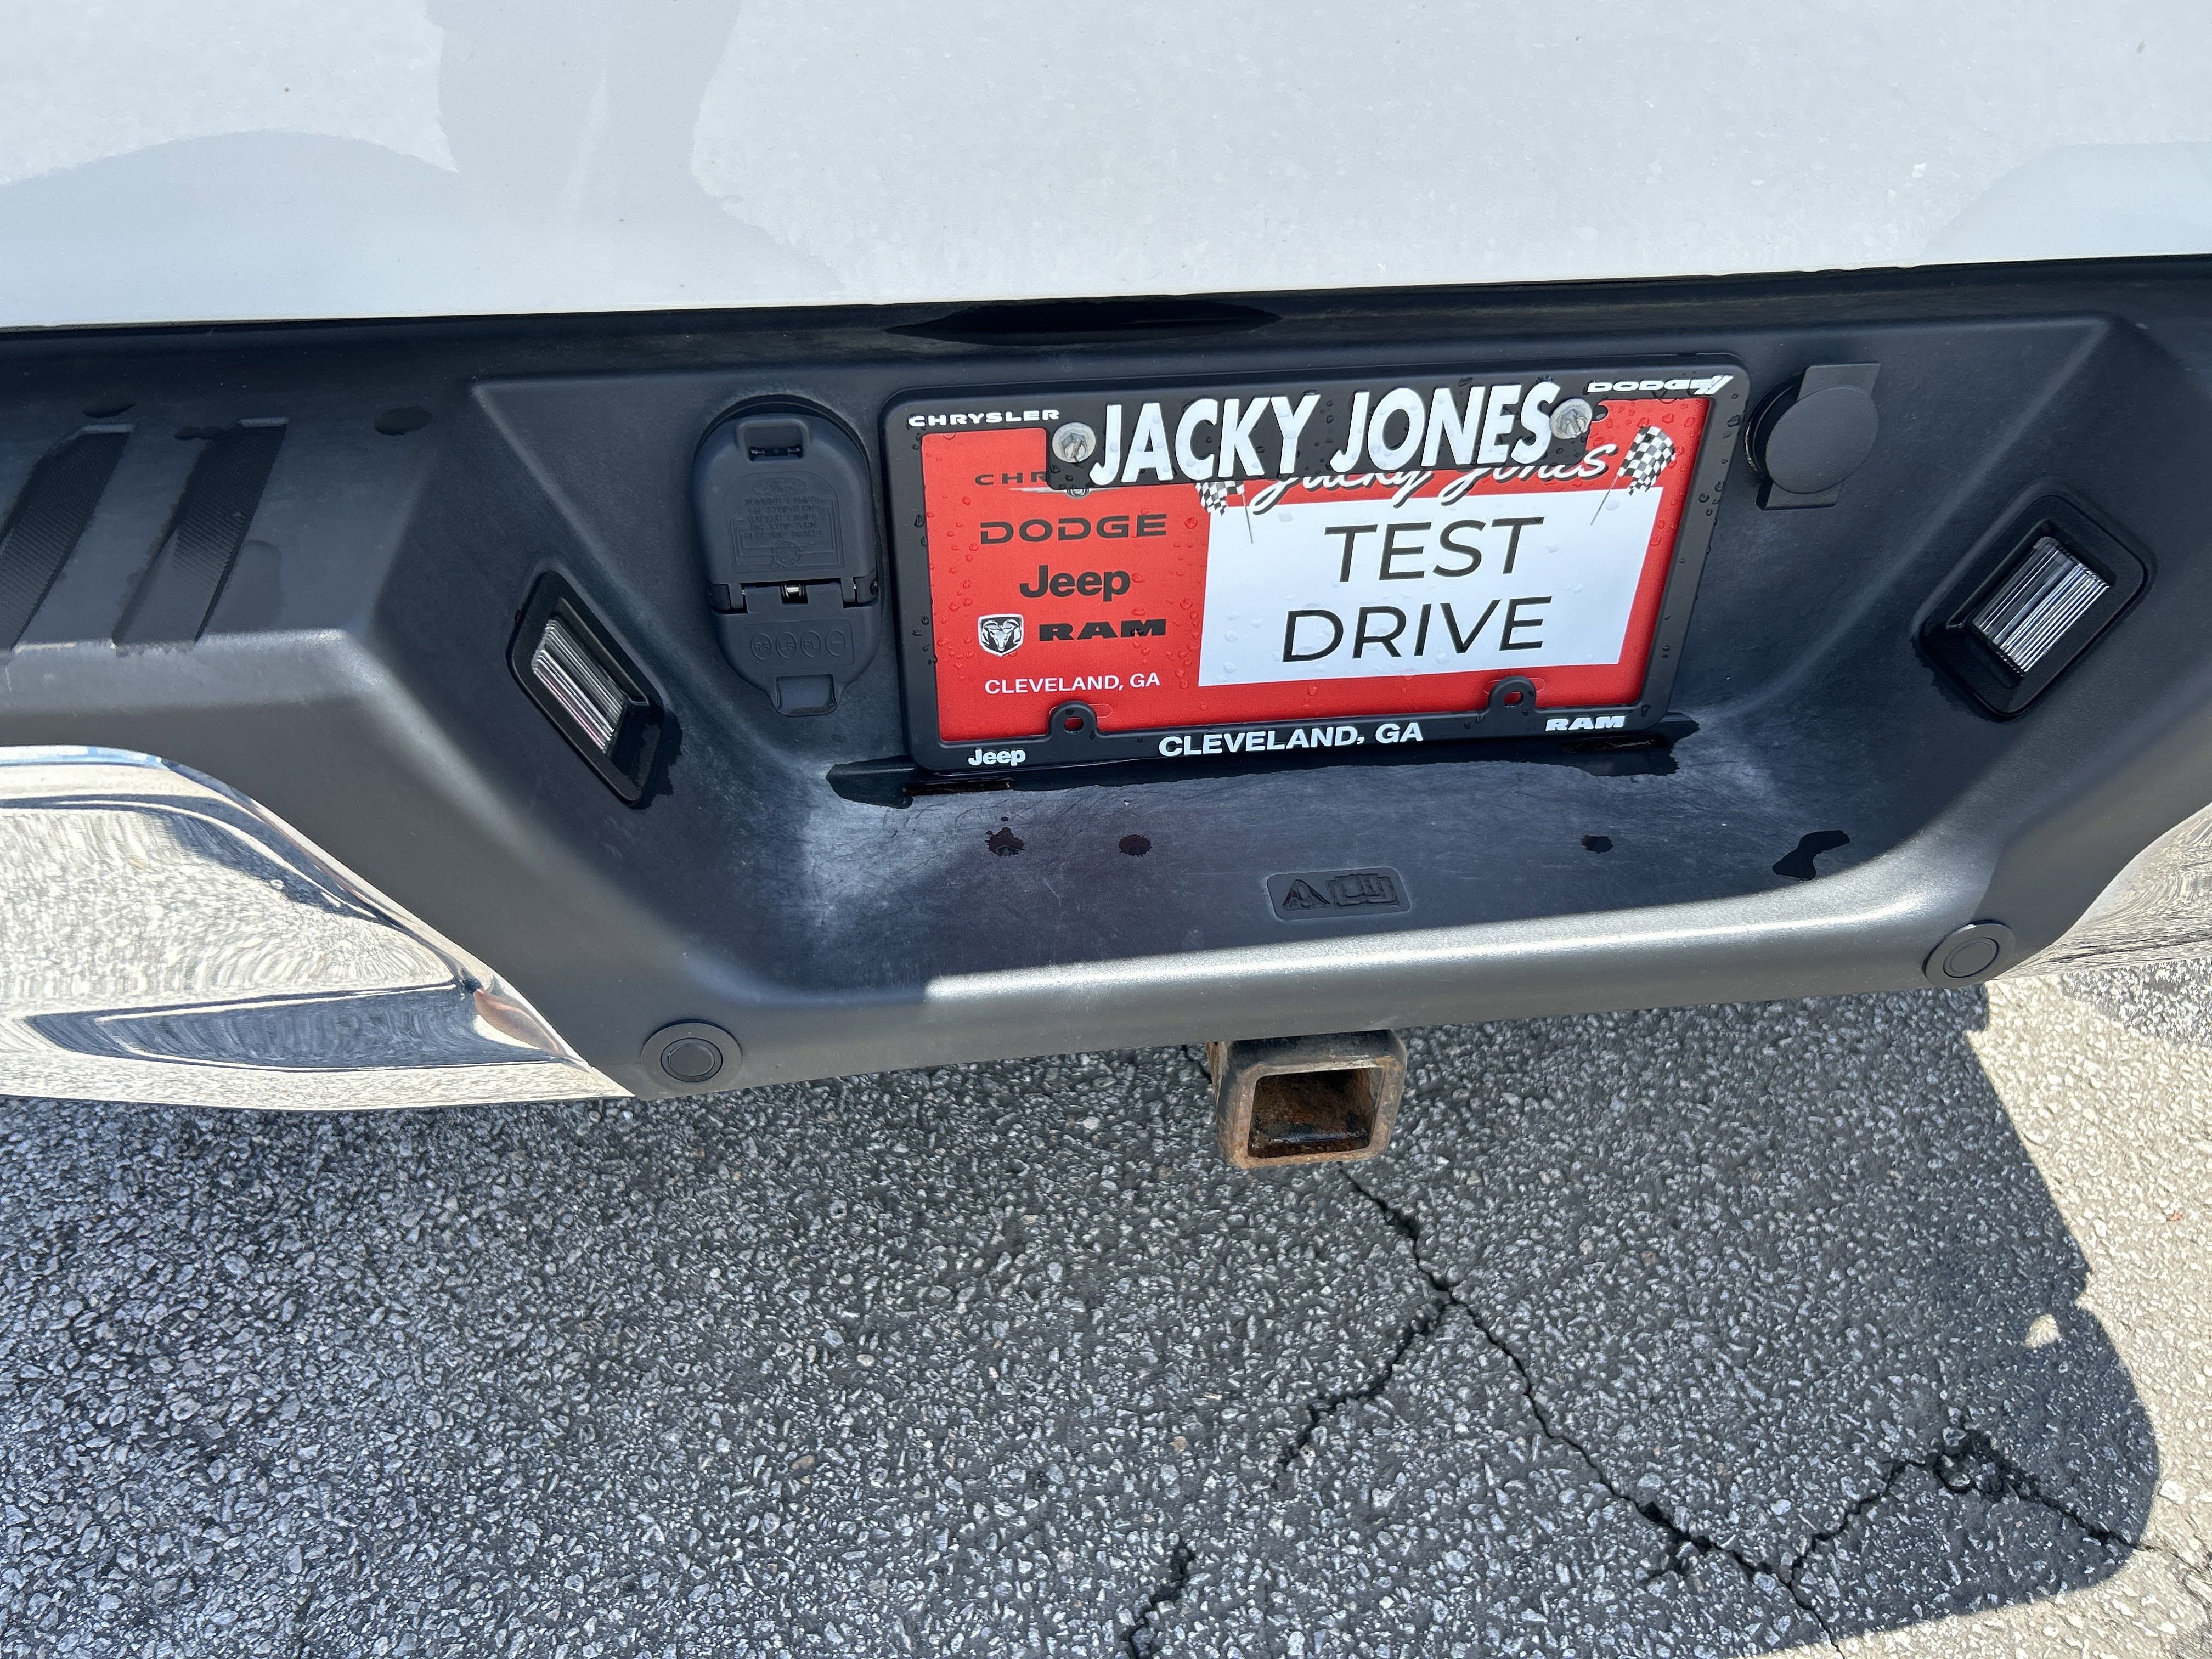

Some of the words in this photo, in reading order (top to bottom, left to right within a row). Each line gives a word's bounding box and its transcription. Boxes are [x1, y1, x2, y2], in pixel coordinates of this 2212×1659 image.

[1587, 378, 1713, 393] DODGE
[908, 409, 1060, 427] CHRYSLER
[1089, 394, 1320, 485] JACKY
[1330, 381, 1561, 472] JONES
[980, 514, 1167, 545] DODGE
[1324, 516, 1546, 584] TEST
[1019, 565, 1131, 602] Jeep
[1039, 618, 1167, 642] RAM
[1282, 596, 1553, 663] DRIVE
[984, 674, 1125, 696] CLEVELAND,
[1129, 672, 1161, 689] GA
[1544, 715, 1627, 732] RAM
[1158, 723, 1366, 757] CLEVELAND,
[1375, 720, 1424, 743] GA
[968, 749, 1027, 766] Jeep
